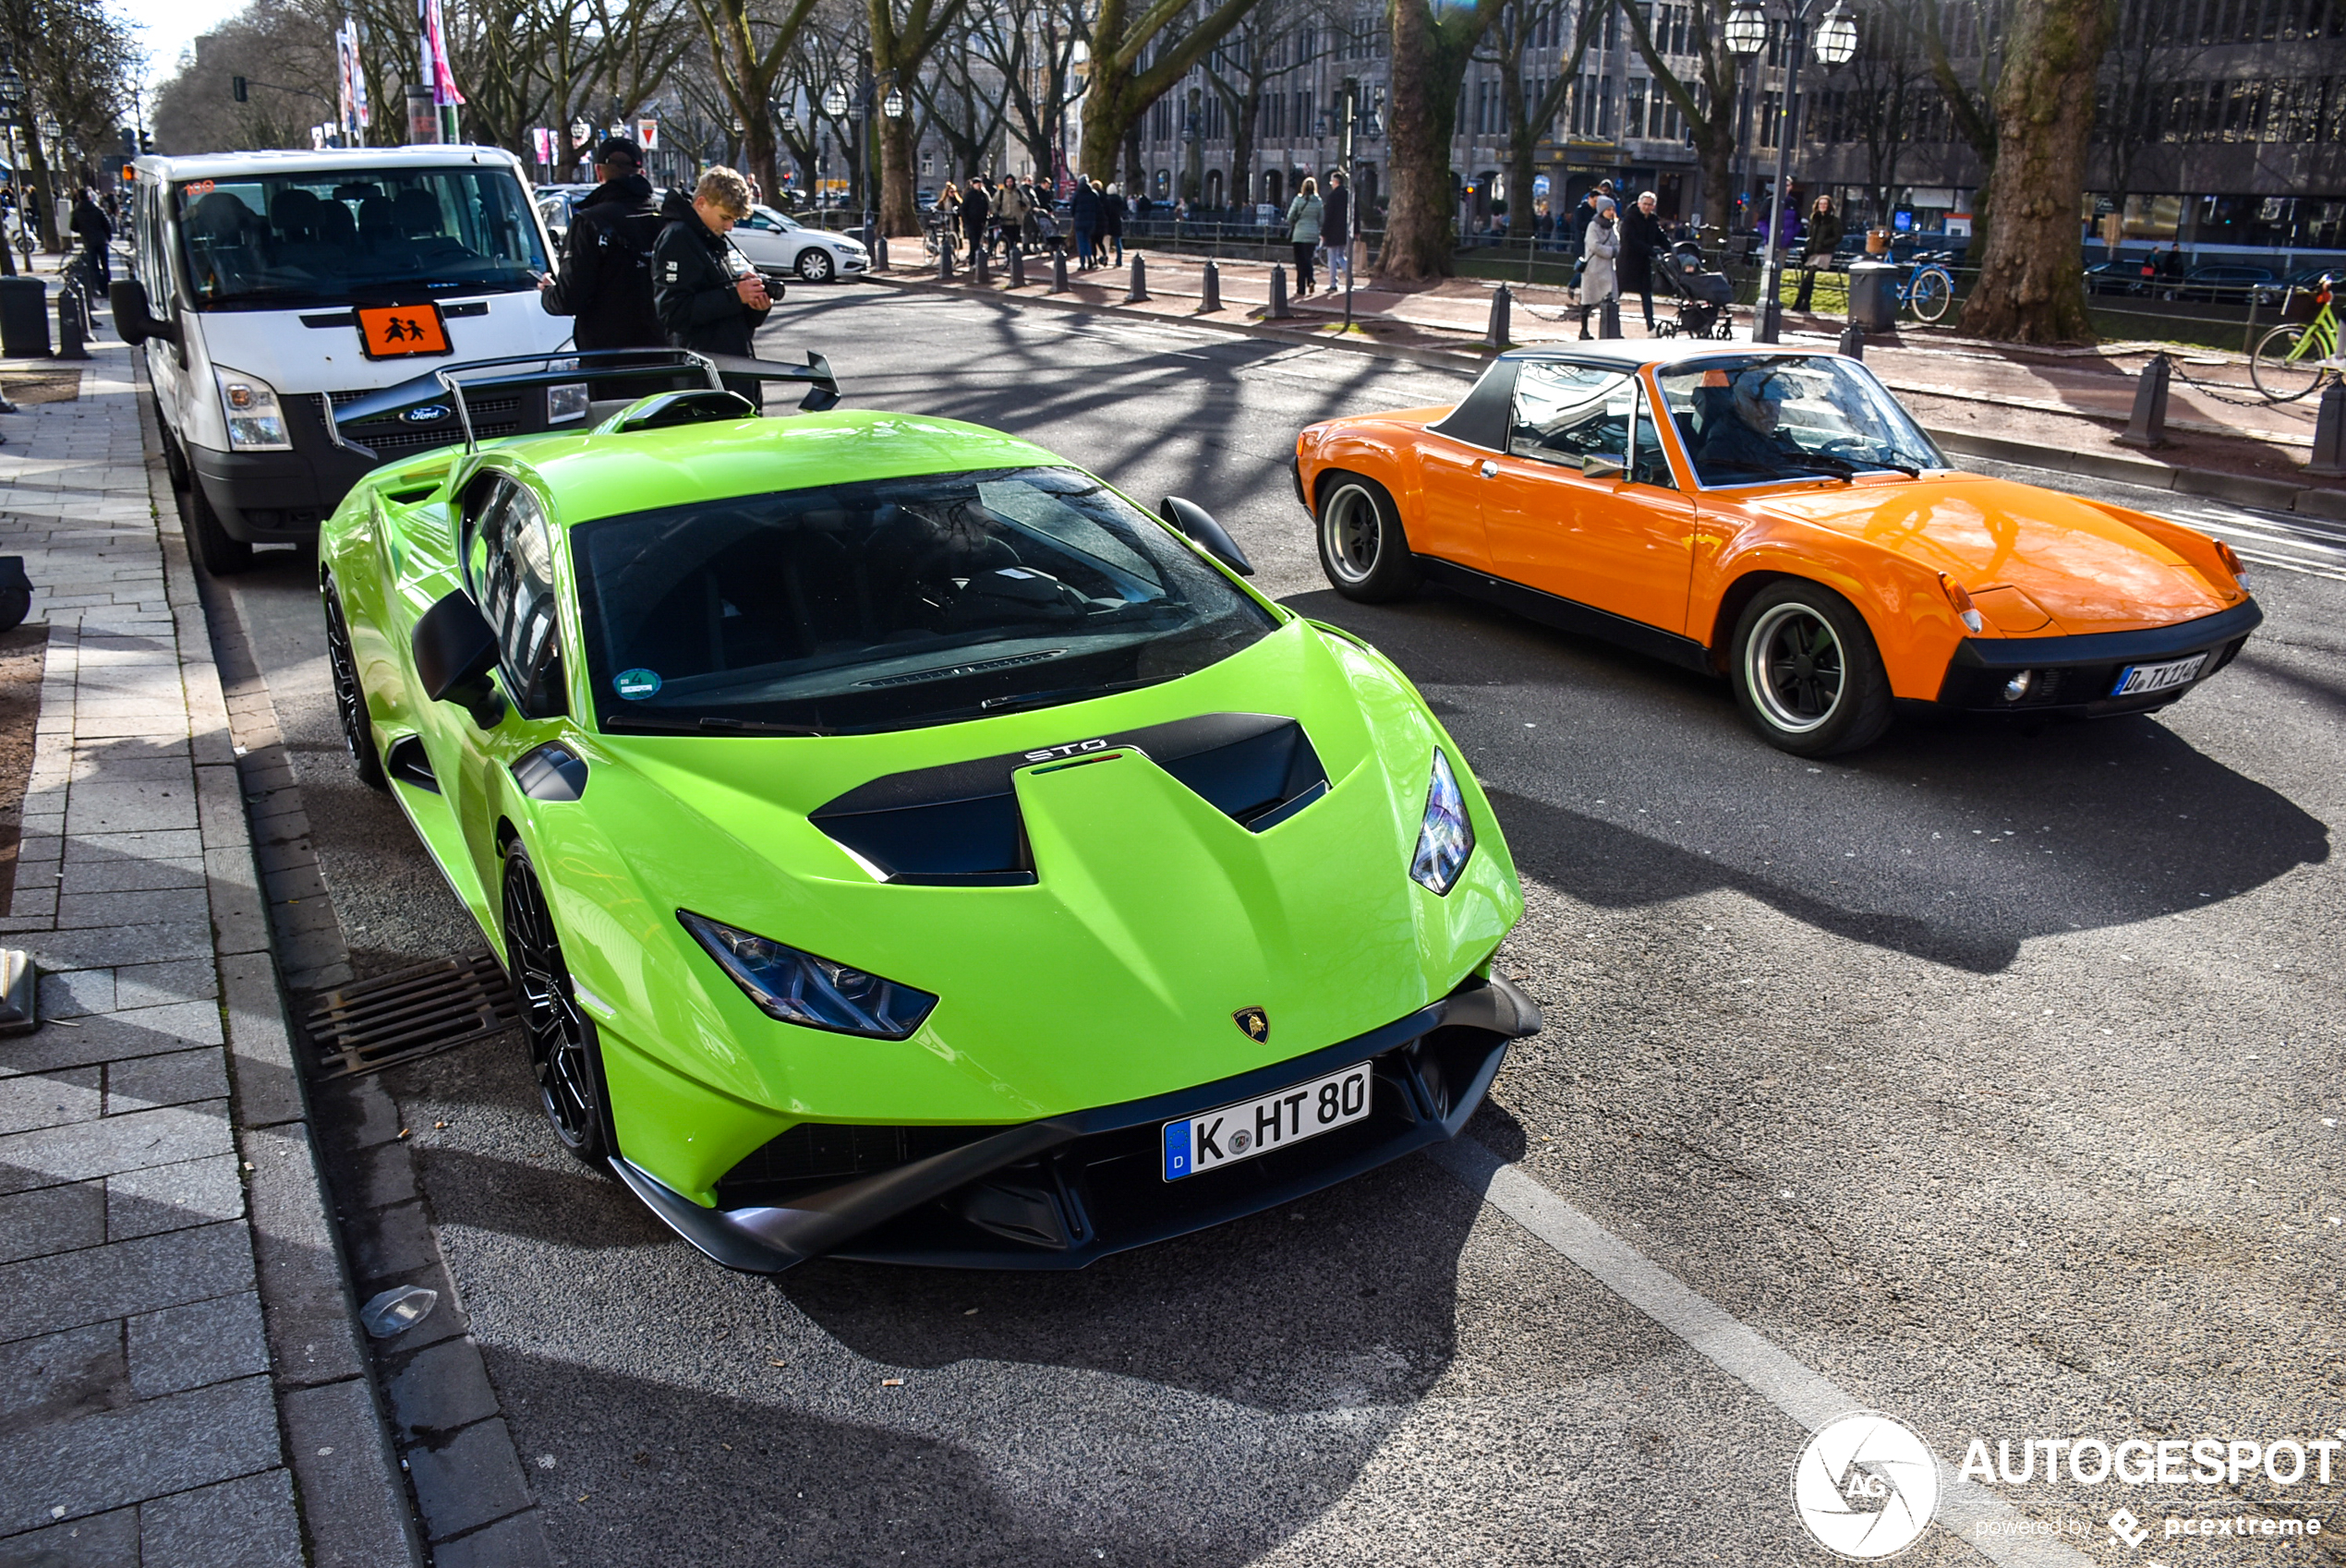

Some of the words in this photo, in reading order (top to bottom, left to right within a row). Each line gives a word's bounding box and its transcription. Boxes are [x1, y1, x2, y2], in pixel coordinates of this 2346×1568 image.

[411, 407, 439, 420] Ford
[631, 672, 643, 684] 4
[2122, 670, 2143, 692] D
[1024, 739, 1107, 762] STO
[1196, 1116, 1225, 1165] K
[1255, 1091, 1309, 1148] HT
[1317, 1073, 1365, 1125] 80
[1173, 1155, 1184, 1169] D
